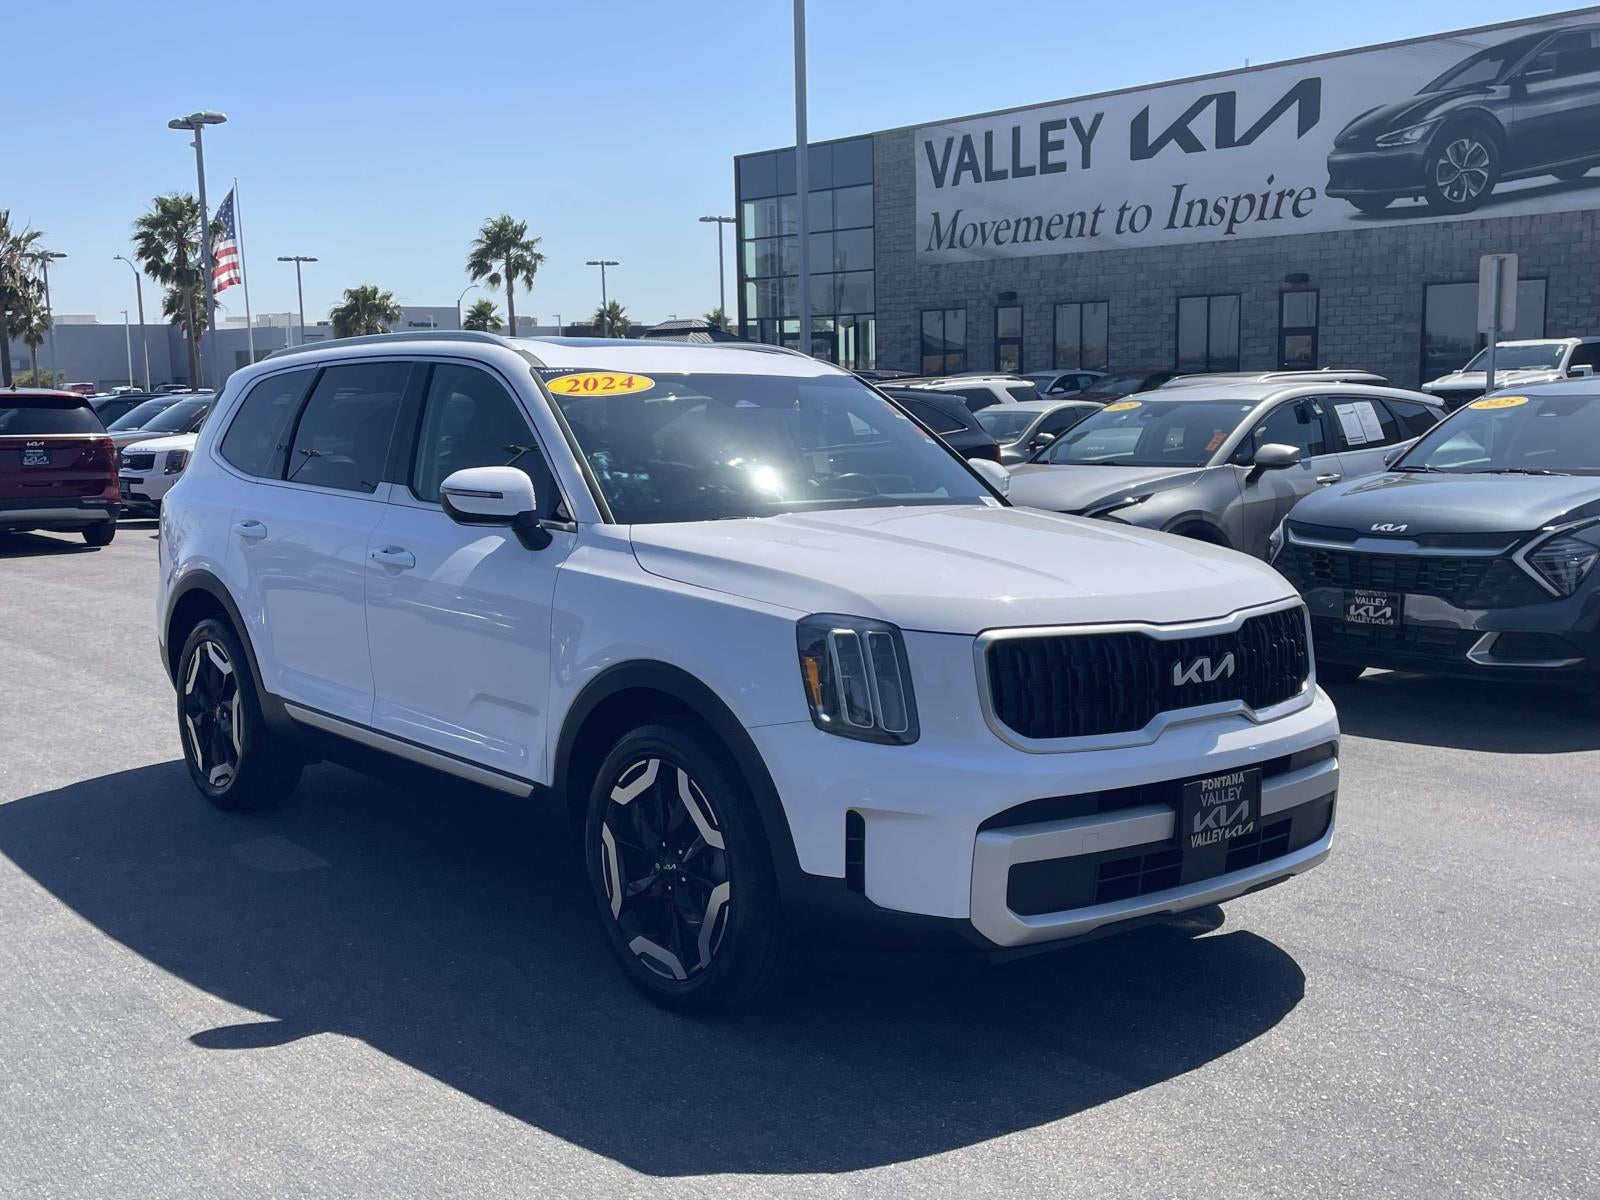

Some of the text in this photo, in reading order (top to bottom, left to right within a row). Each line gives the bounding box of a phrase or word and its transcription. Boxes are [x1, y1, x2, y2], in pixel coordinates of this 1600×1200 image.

[924, 77, 1321, 188] VALLEY KIA
[924, 174, 1317, 252] Movement to Inspire
[565, 375, 635, 393] 2024
[1370, 523, 1408, 532] KIA
[1355, 596, 1387, 606] VALLEY
[1346, 614, 1370, 624] VALLEY
[1350, 605, 1391, 618] KIA
[1173, 652, 1235, 686] KIA
[1201, 772, 1245, 791] FONTANA
[1200, 785, 1242, 807] VALLEY
[1193, 800, 1249, 833] KIA
[1191, 821, 1254, 849] VALLEY KIA
